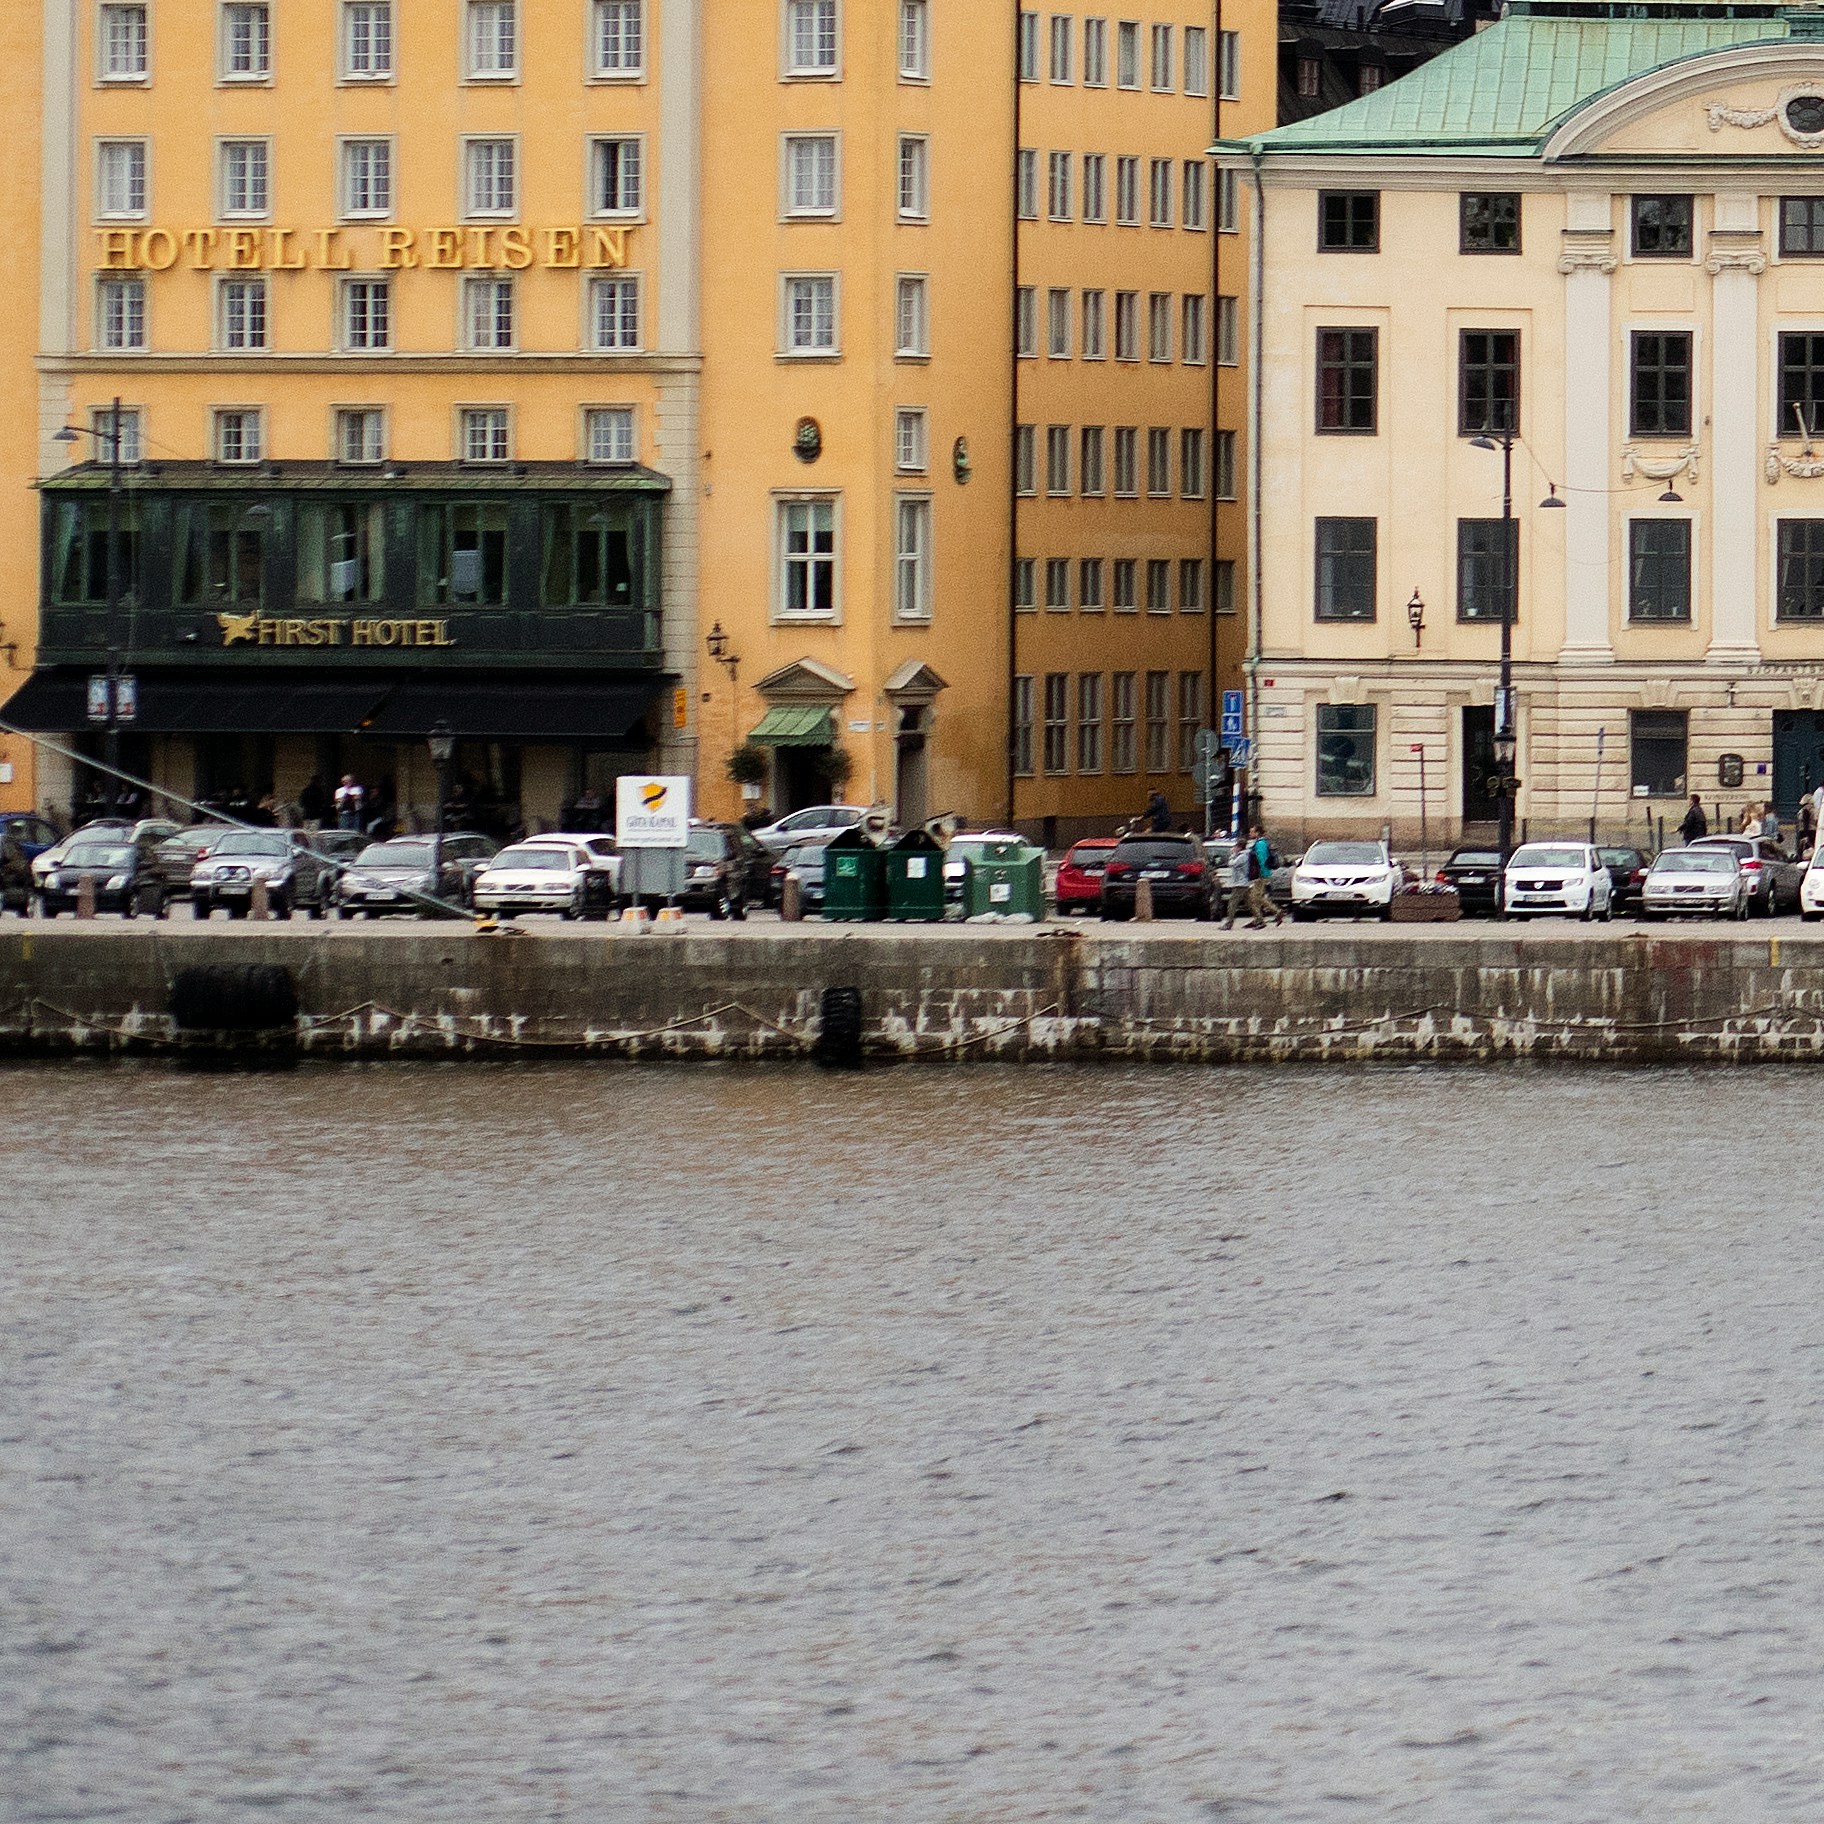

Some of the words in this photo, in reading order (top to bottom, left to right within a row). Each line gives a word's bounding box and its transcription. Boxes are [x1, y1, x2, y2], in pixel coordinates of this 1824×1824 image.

[95, 228, 352, 271] HOTELL
[375, 226, 634, 270] REISEN
[257, 618, 347, 646] FIRST
[351, 618, 455, 646] HOTEL
